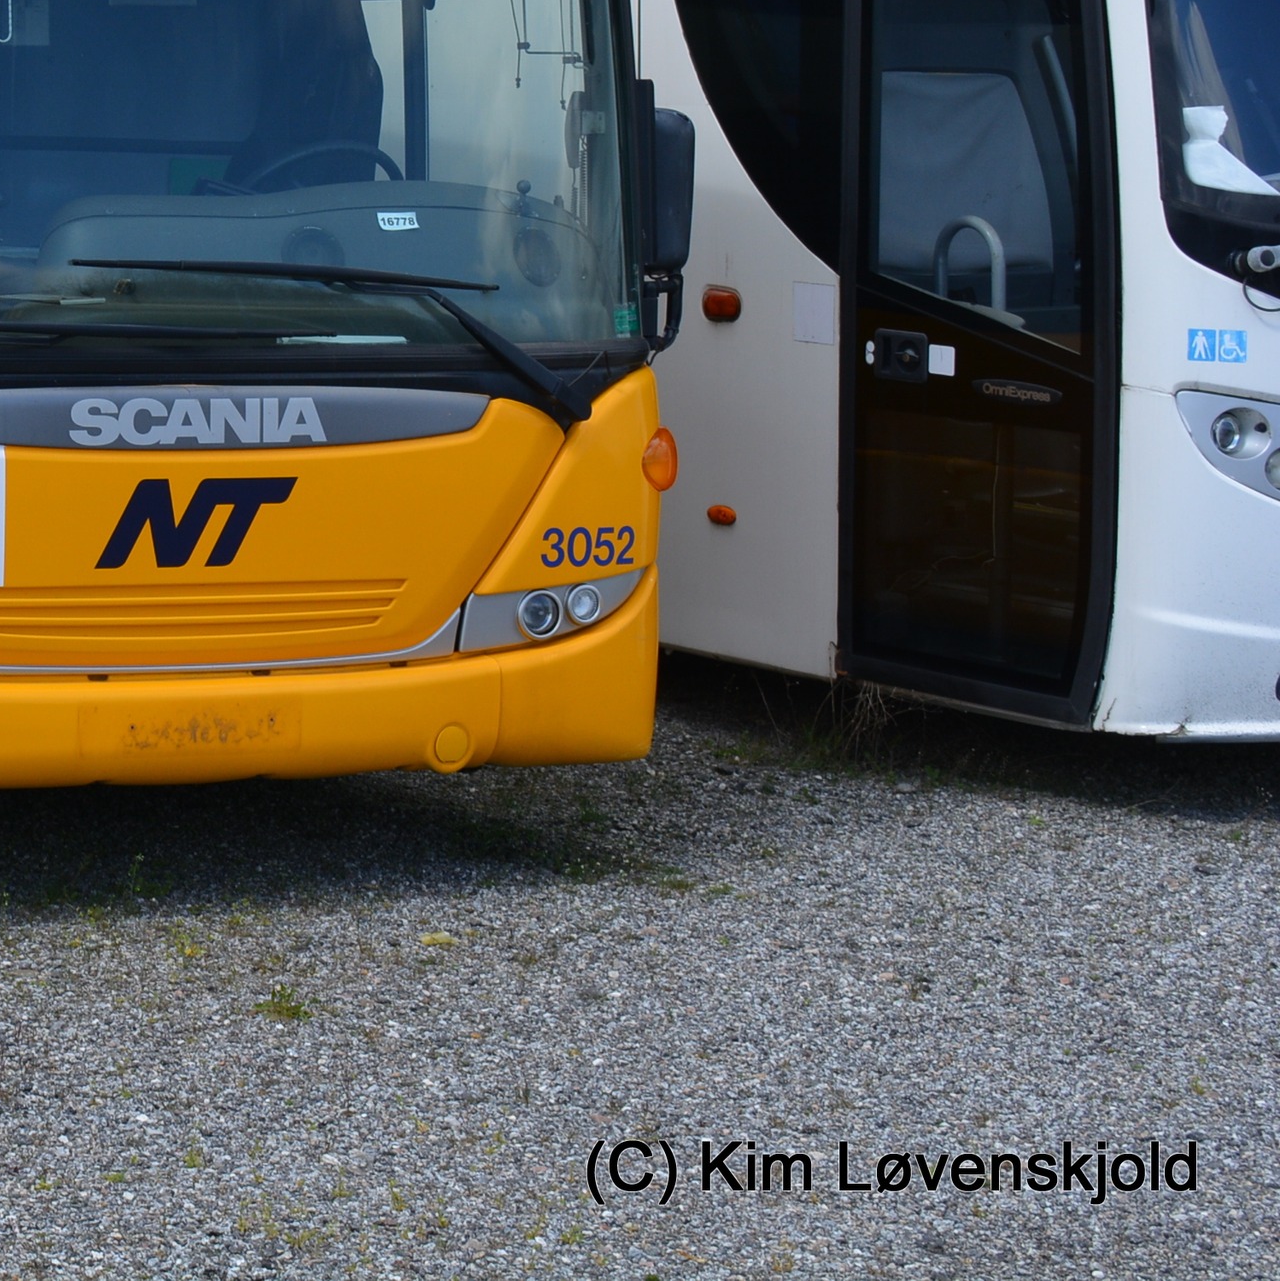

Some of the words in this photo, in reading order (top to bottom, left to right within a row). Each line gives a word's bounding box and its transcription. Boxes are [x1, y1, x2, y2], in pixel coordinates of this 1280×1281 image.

[380, 217, 415, 226] 16778
[982, 382, 1051, 402] OmniExpress
[68, 397, 327, 446] SCANIA
[94, 477, 299, 569] NT
[541, 525, 635, 568] 3052
